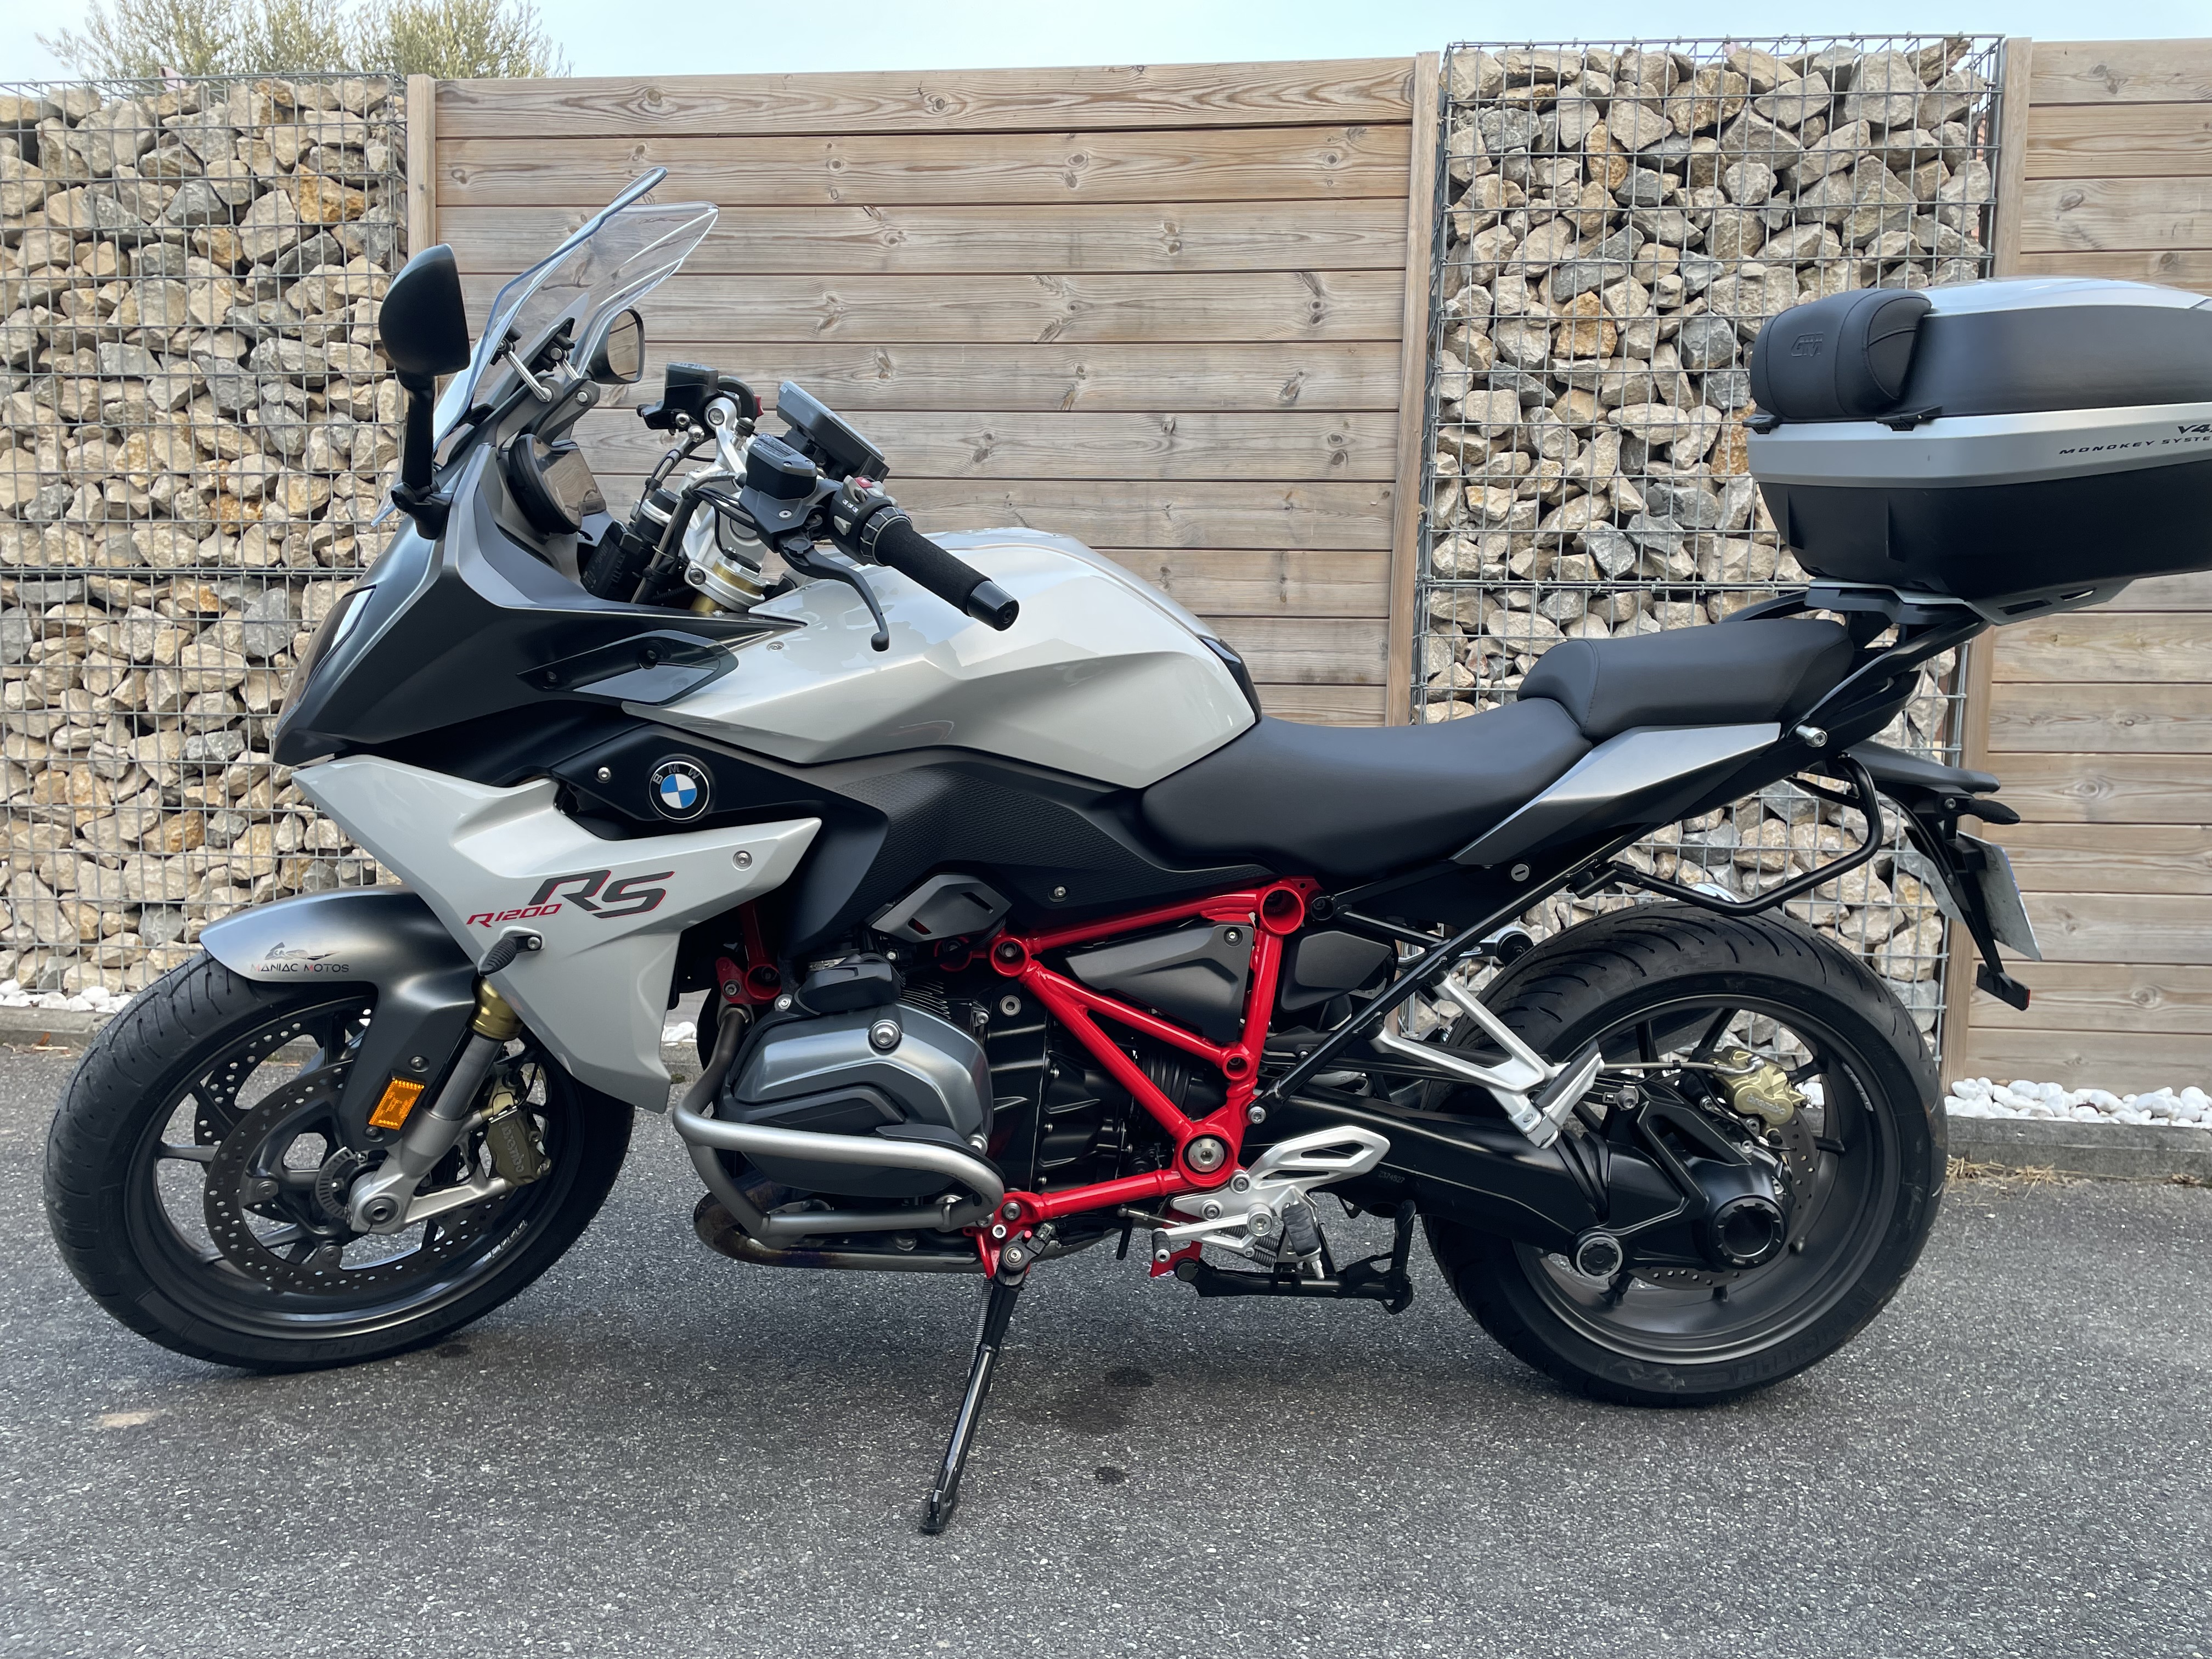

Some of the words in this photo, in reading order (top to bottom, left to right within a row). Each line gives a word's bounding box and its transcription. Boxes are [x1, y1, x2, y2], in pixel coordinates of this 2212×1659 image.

[2177, 424, 2212, 435] V4
[2059, 441, 2155, 455] MONOKEY
[2162, 436, 2211, 444] SYSTE
[652, 763, 701, 785] BMW
[466, 903, 562, 928] R1200
[528, 869, 675, 919] RS
[250, 963, 298, 973] MANIAC
[303, 963, 349, 973] MOTOS
[501, 1124, 524, 1173] brembo
